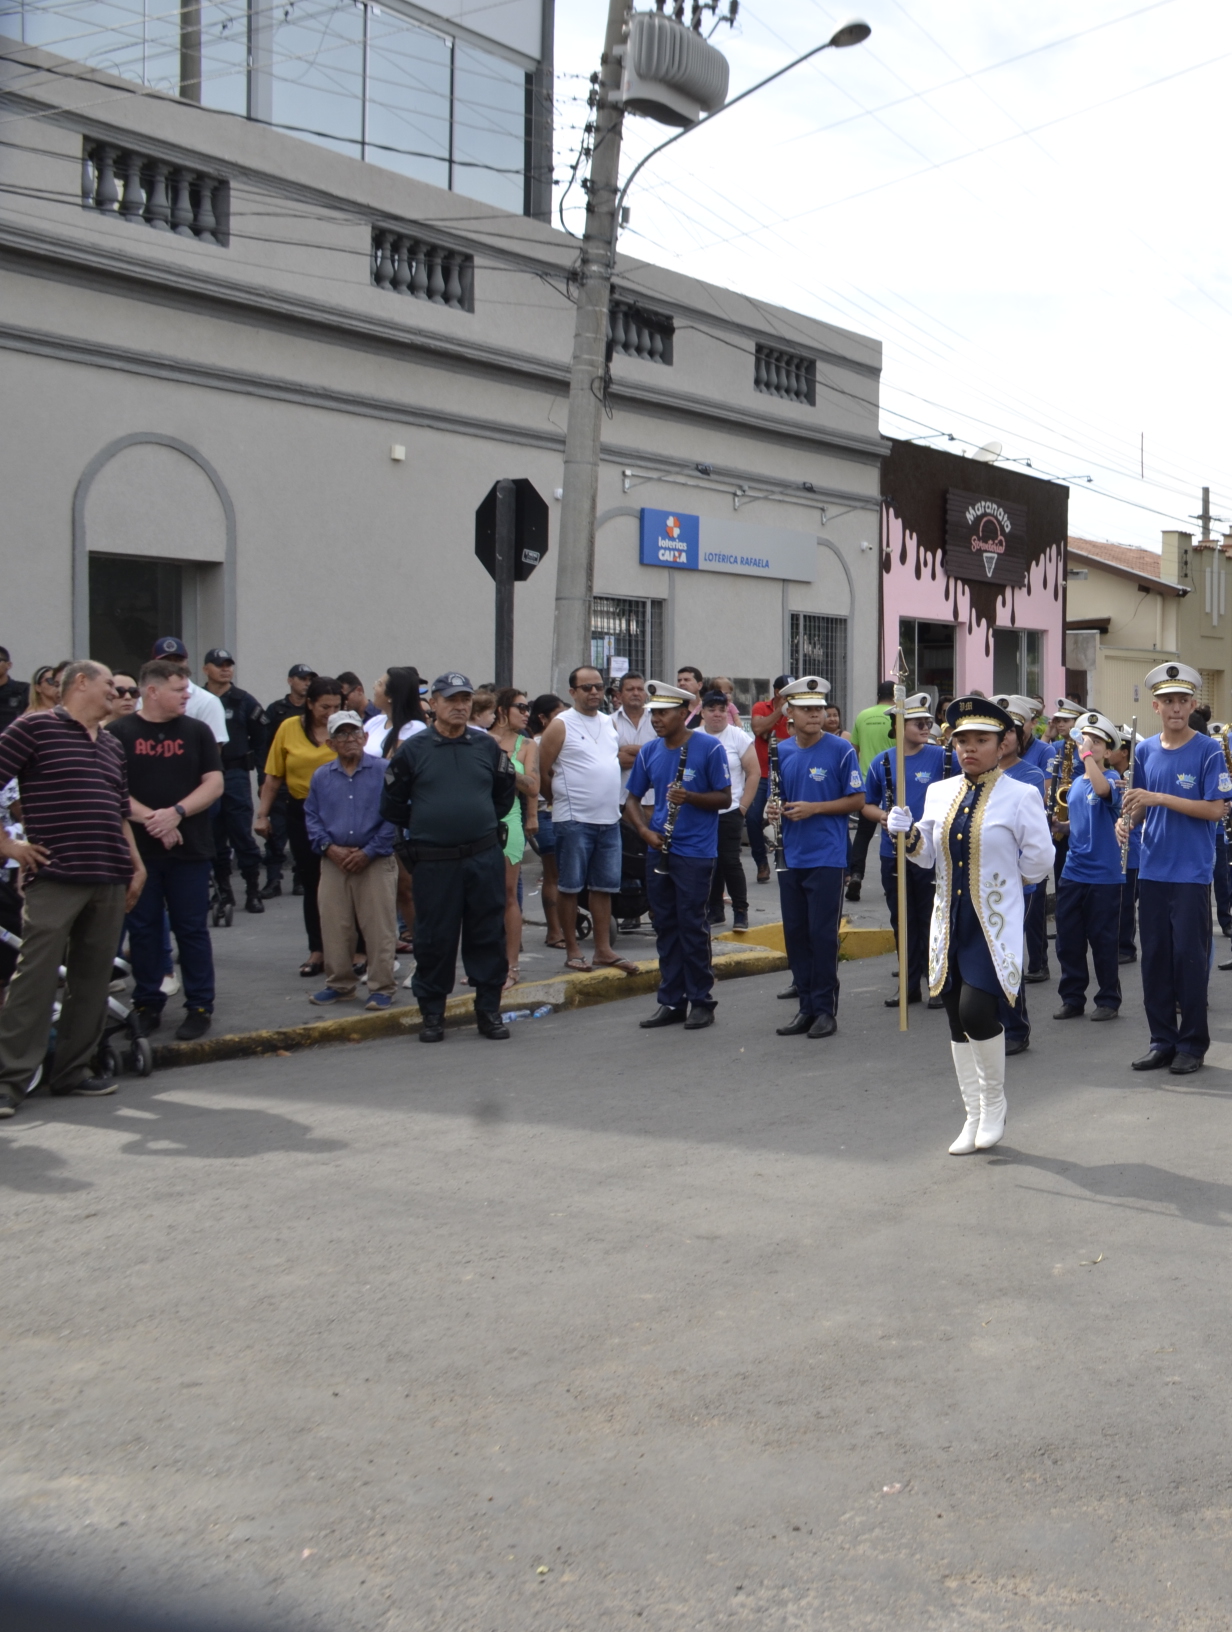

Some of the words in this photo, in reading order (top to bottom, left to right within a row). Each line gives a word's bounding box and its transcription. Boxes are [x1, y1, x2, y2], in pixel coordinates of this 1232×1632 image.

[658, 536, 687, 550] loterias
[658, 549, 687, 563] CAIXA
[703, 550, 738, 565] LOTÉRICA
[740, 556, 770, 569] RAFAELA
